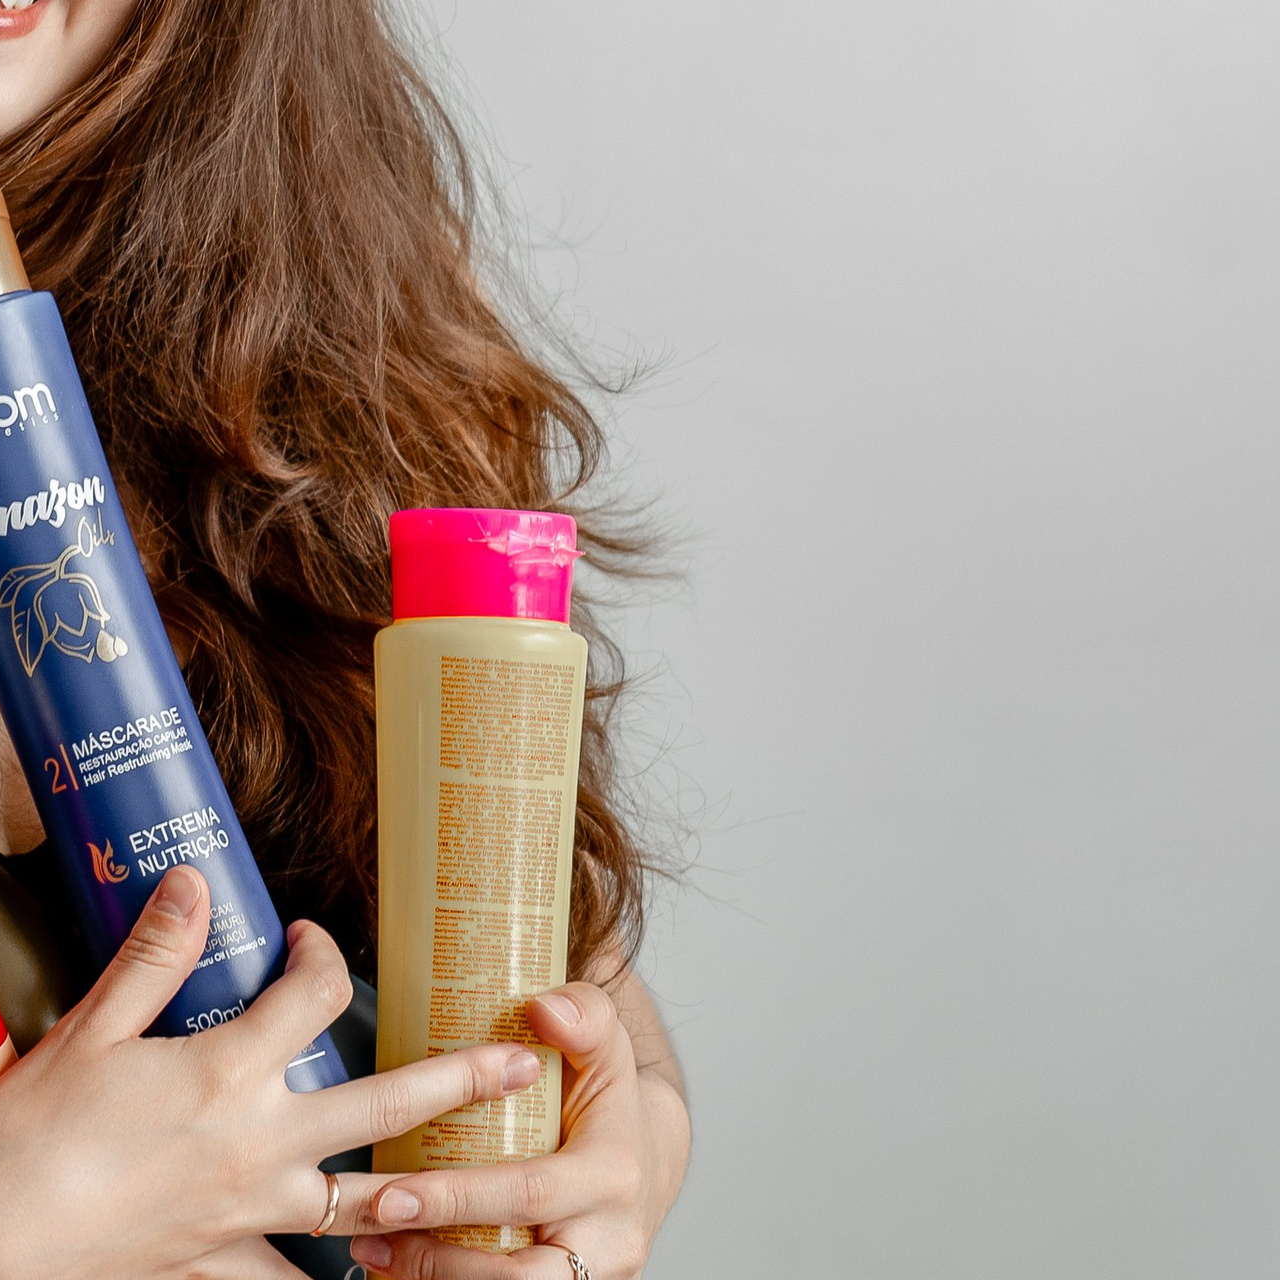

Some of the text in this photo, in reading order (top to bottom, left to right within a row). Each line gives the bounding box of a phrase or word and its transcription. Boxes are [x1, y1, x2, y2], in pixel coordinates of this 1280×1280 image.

[77, 507, 115, 558] Oils
[72, 706, 182, 760] MÁSCARA DE
[79, 726, 187, 774] RESTAURAÇÃO CAPILAR
[83, 771, 106, 787] Hair
[170, 738, 193, 756] Mask
[129, 805, 221, 853] EXTREMA
[137, 828, 229, 877] NUTRIÇÃO
